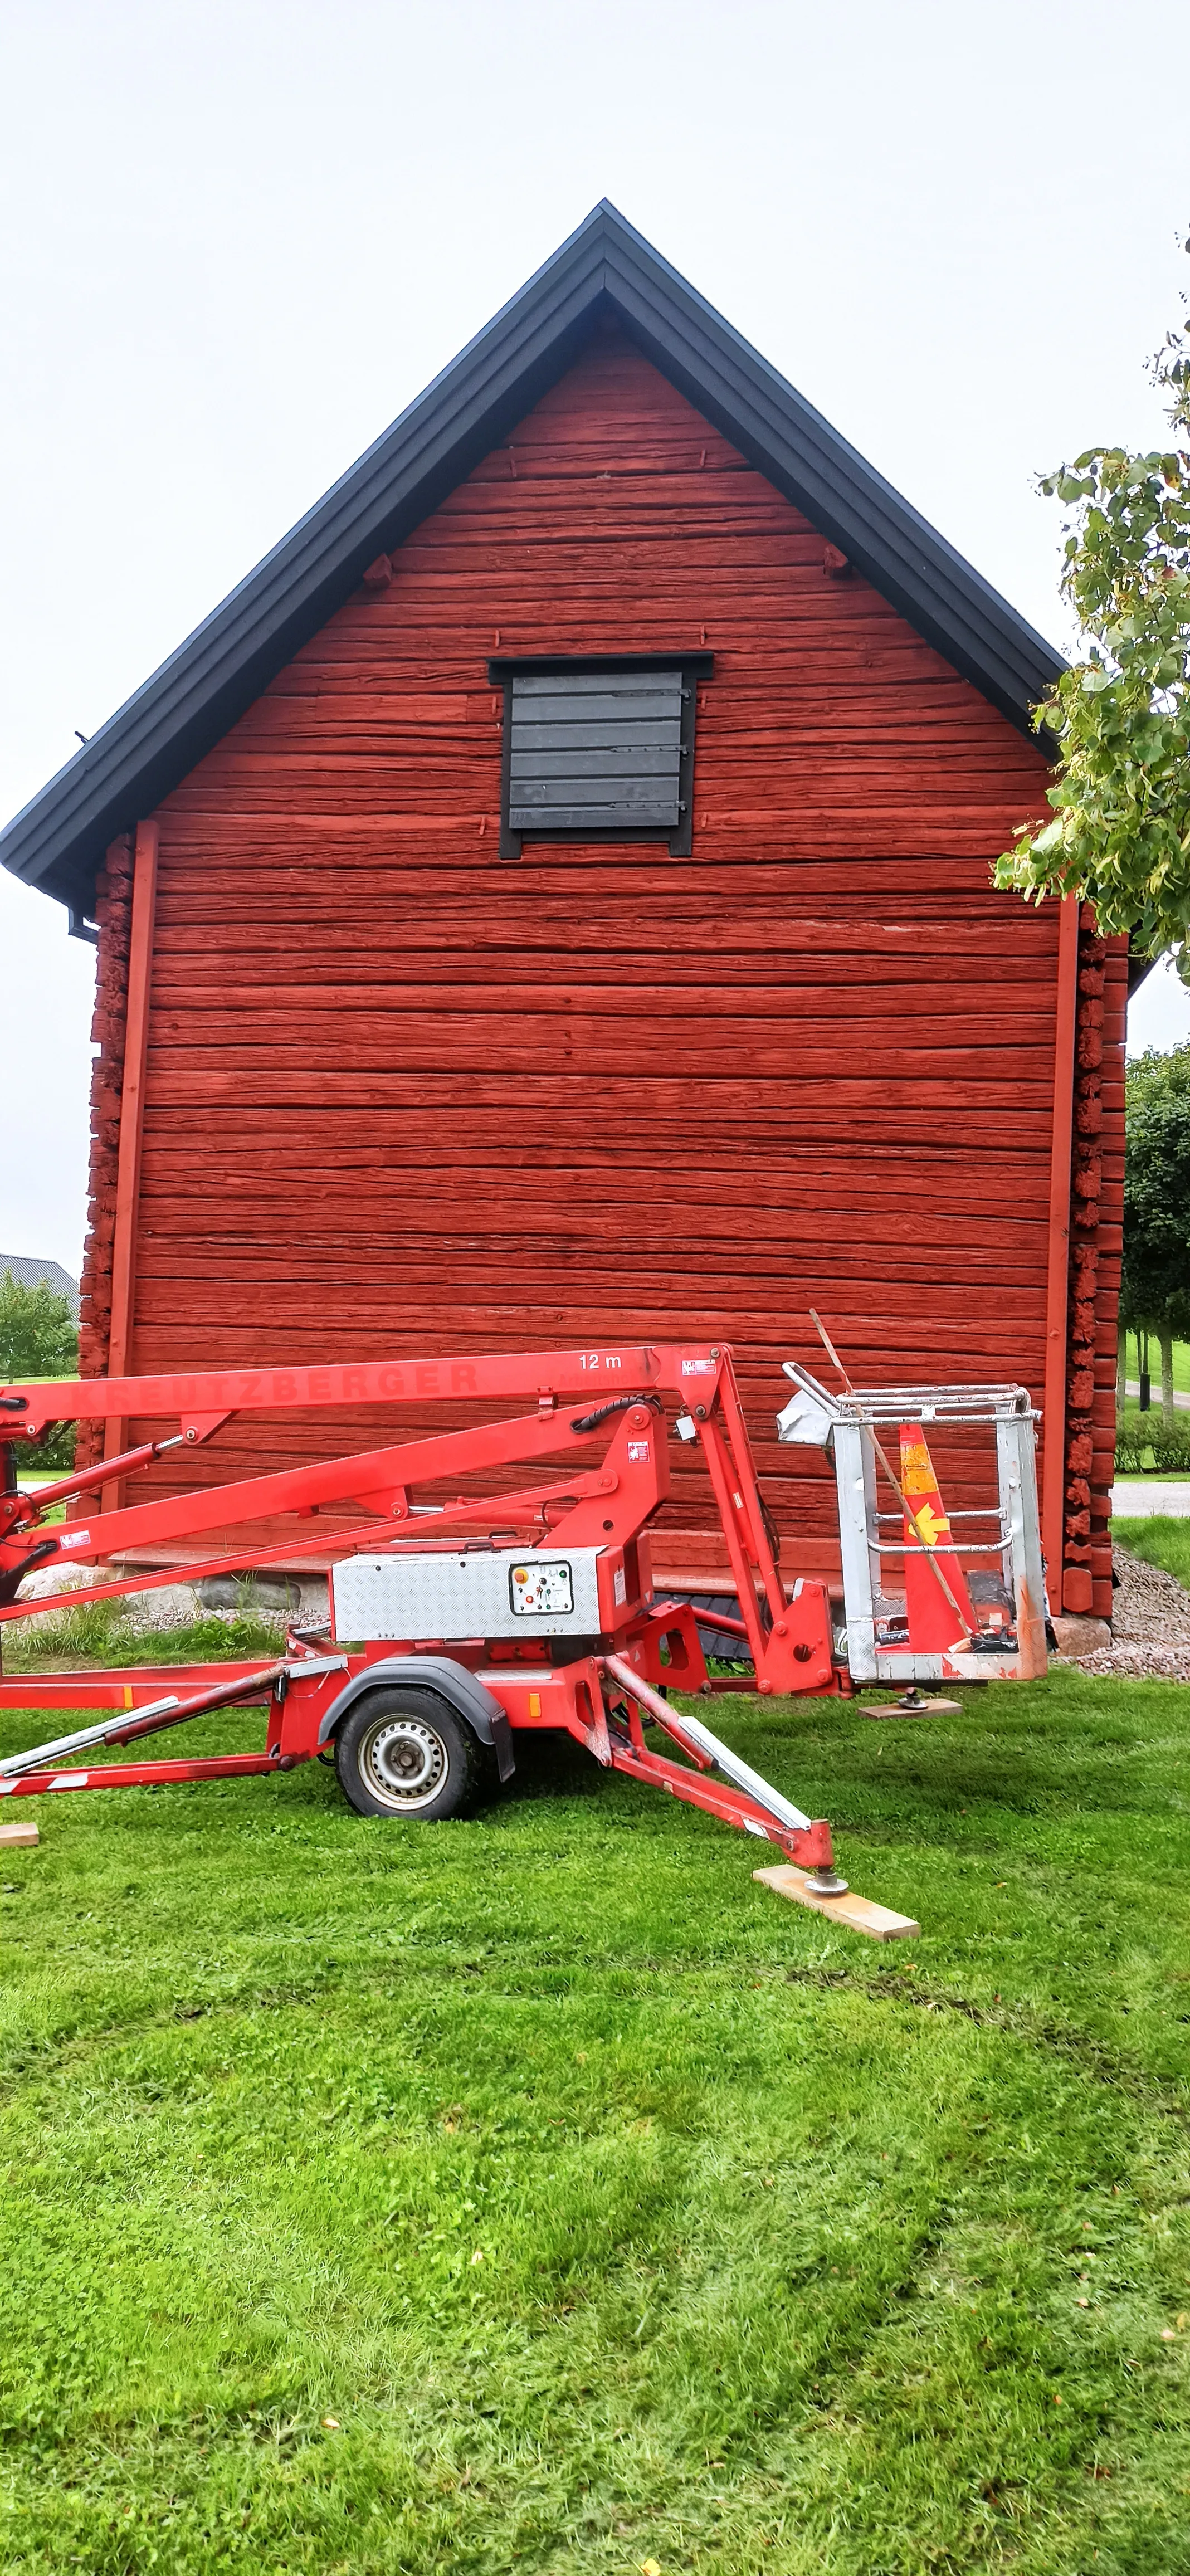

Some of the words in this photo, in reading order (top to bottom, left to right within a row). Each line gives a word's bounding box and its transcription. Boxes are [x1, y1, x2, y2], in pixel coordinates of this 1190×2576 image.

[579, 1354, 599, 1369] 12
[606, 1355, 622, 1369] m
[71, 1364, 478, 1413] KREUTZBERGER
